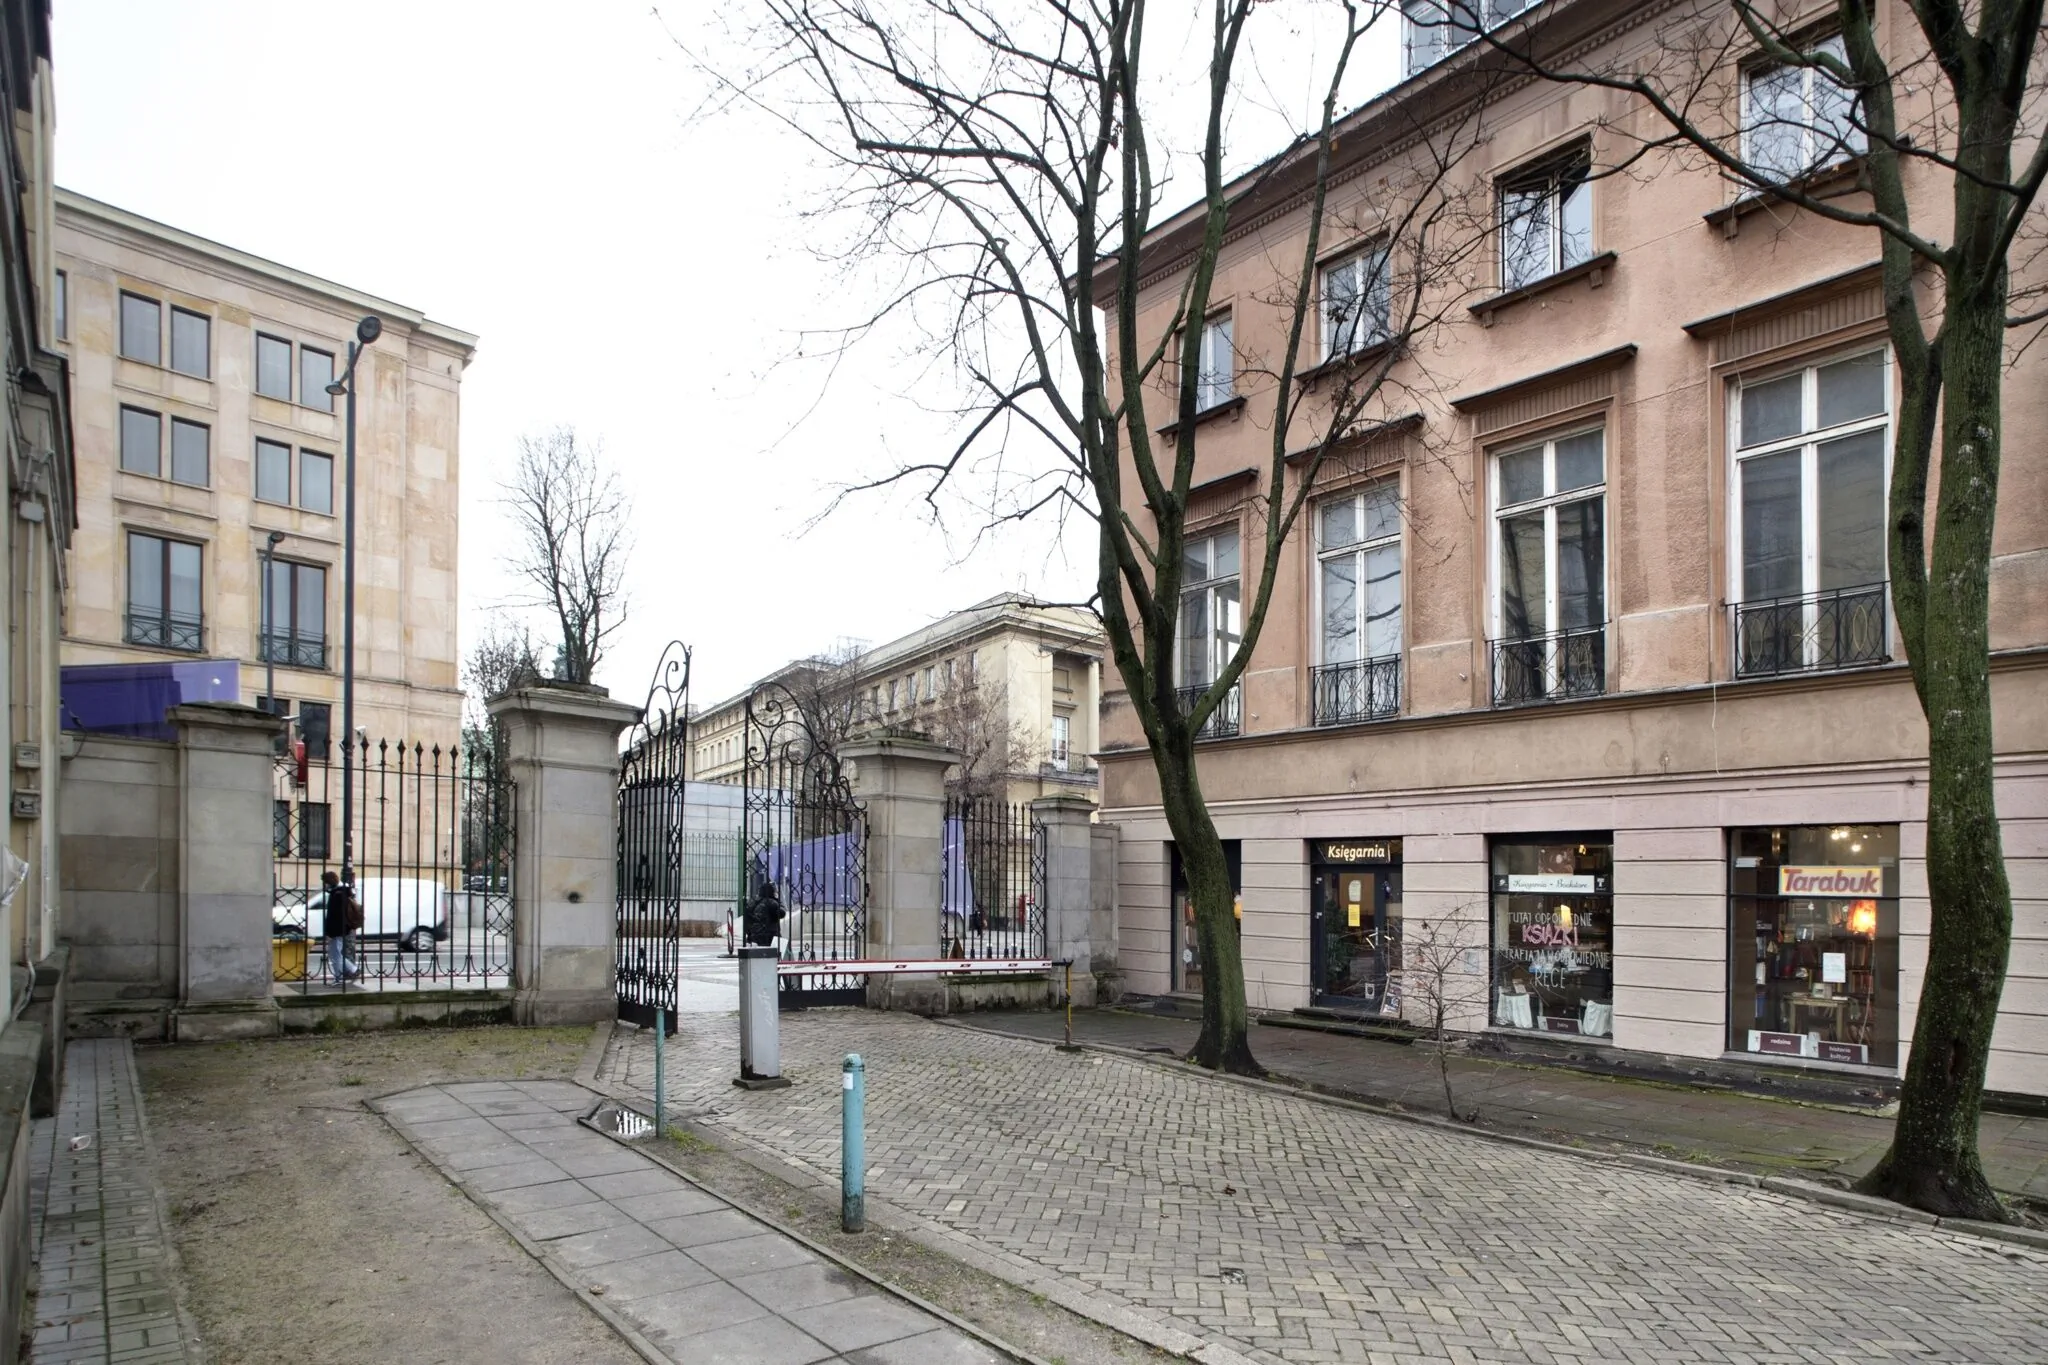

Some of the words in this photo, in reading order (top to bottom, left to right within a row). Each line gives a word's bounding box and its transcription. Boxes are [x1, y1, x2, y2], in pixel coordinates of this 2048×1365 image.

[1327, 844, 1385, 861] Księgarnia
[1783, 868, 1880, 893] Tarabuk
[1508, 912, 1532, 925] TUTAJ
[1535, 912, 1593, 927] ODPODNIE
